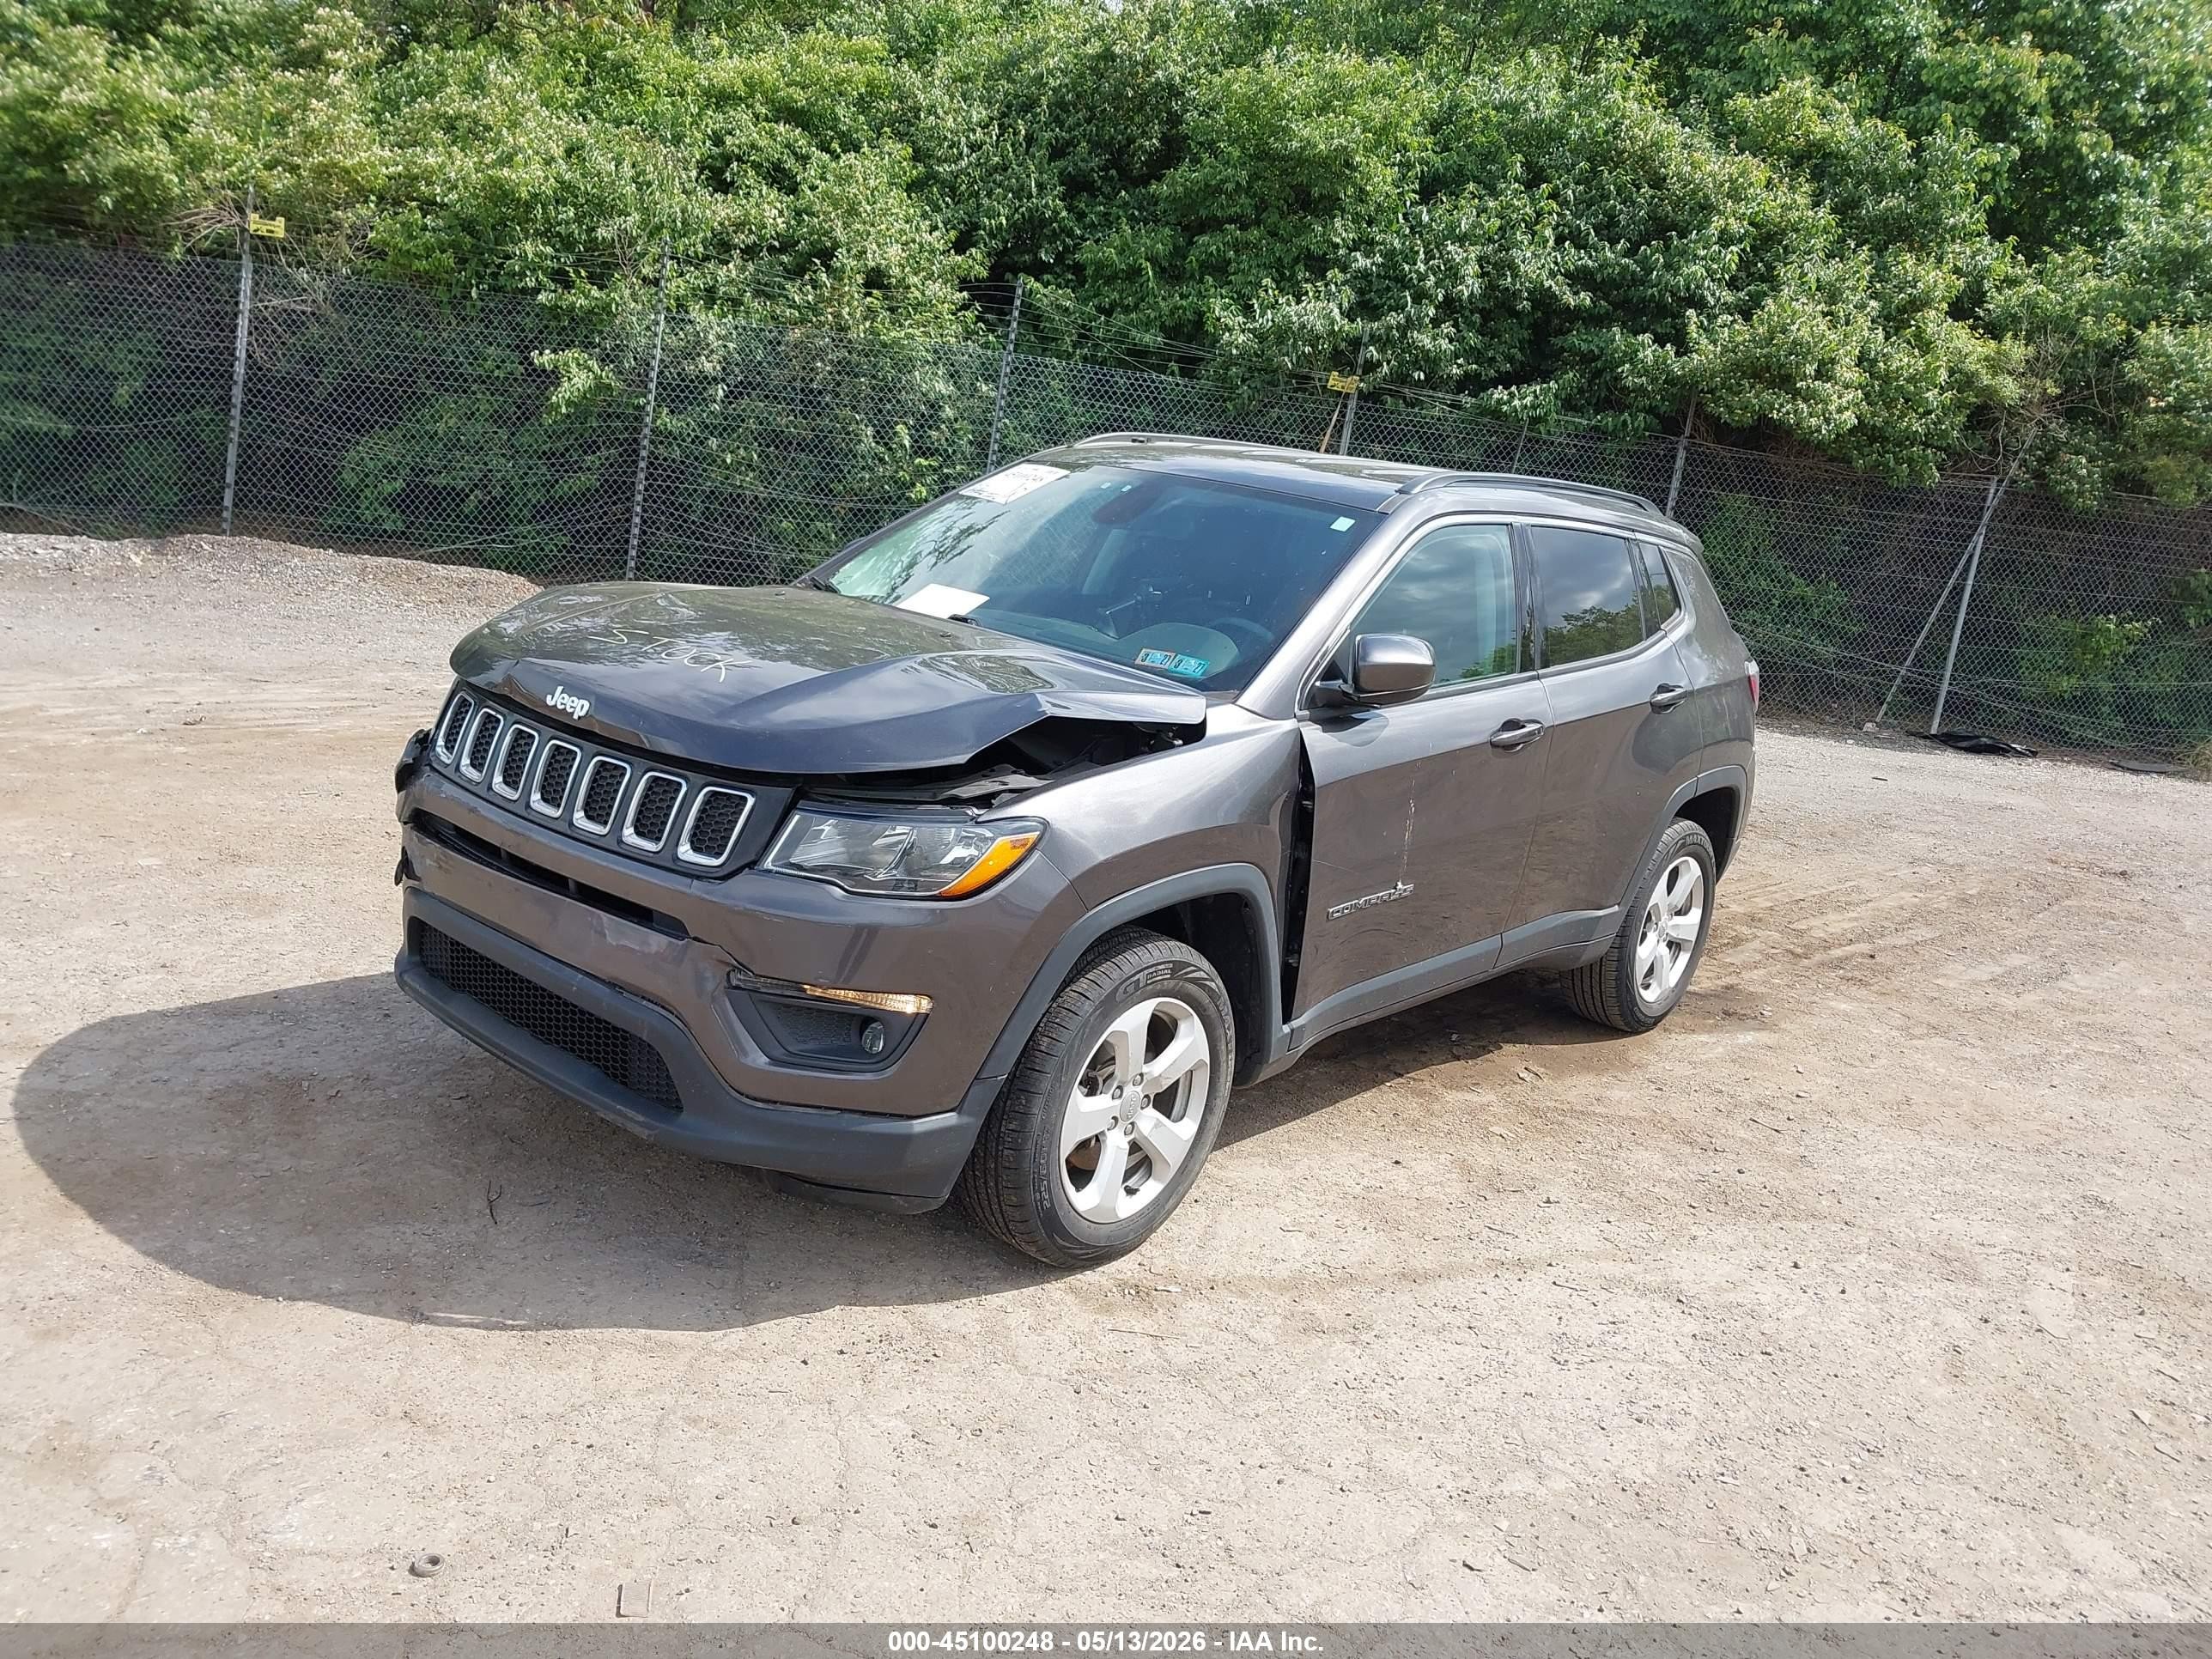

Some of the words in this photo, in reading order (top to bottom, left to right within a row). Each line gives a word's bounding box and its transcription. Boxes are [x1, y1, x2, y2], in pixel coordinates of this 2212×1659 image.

[586, 629, 753, 684] STOCK
[1140, 653, 1150, 663] 3
[1160, 653, 1172, 666] 27
[1173, 659, 1183, 669] 3
[1193, 662, 1206, 674] 27
[545, 685, 590, 720] Jeep
[1327, 882, 1415, 921] COMPASS
[1147, 969, 1173, 980] RADIAL
